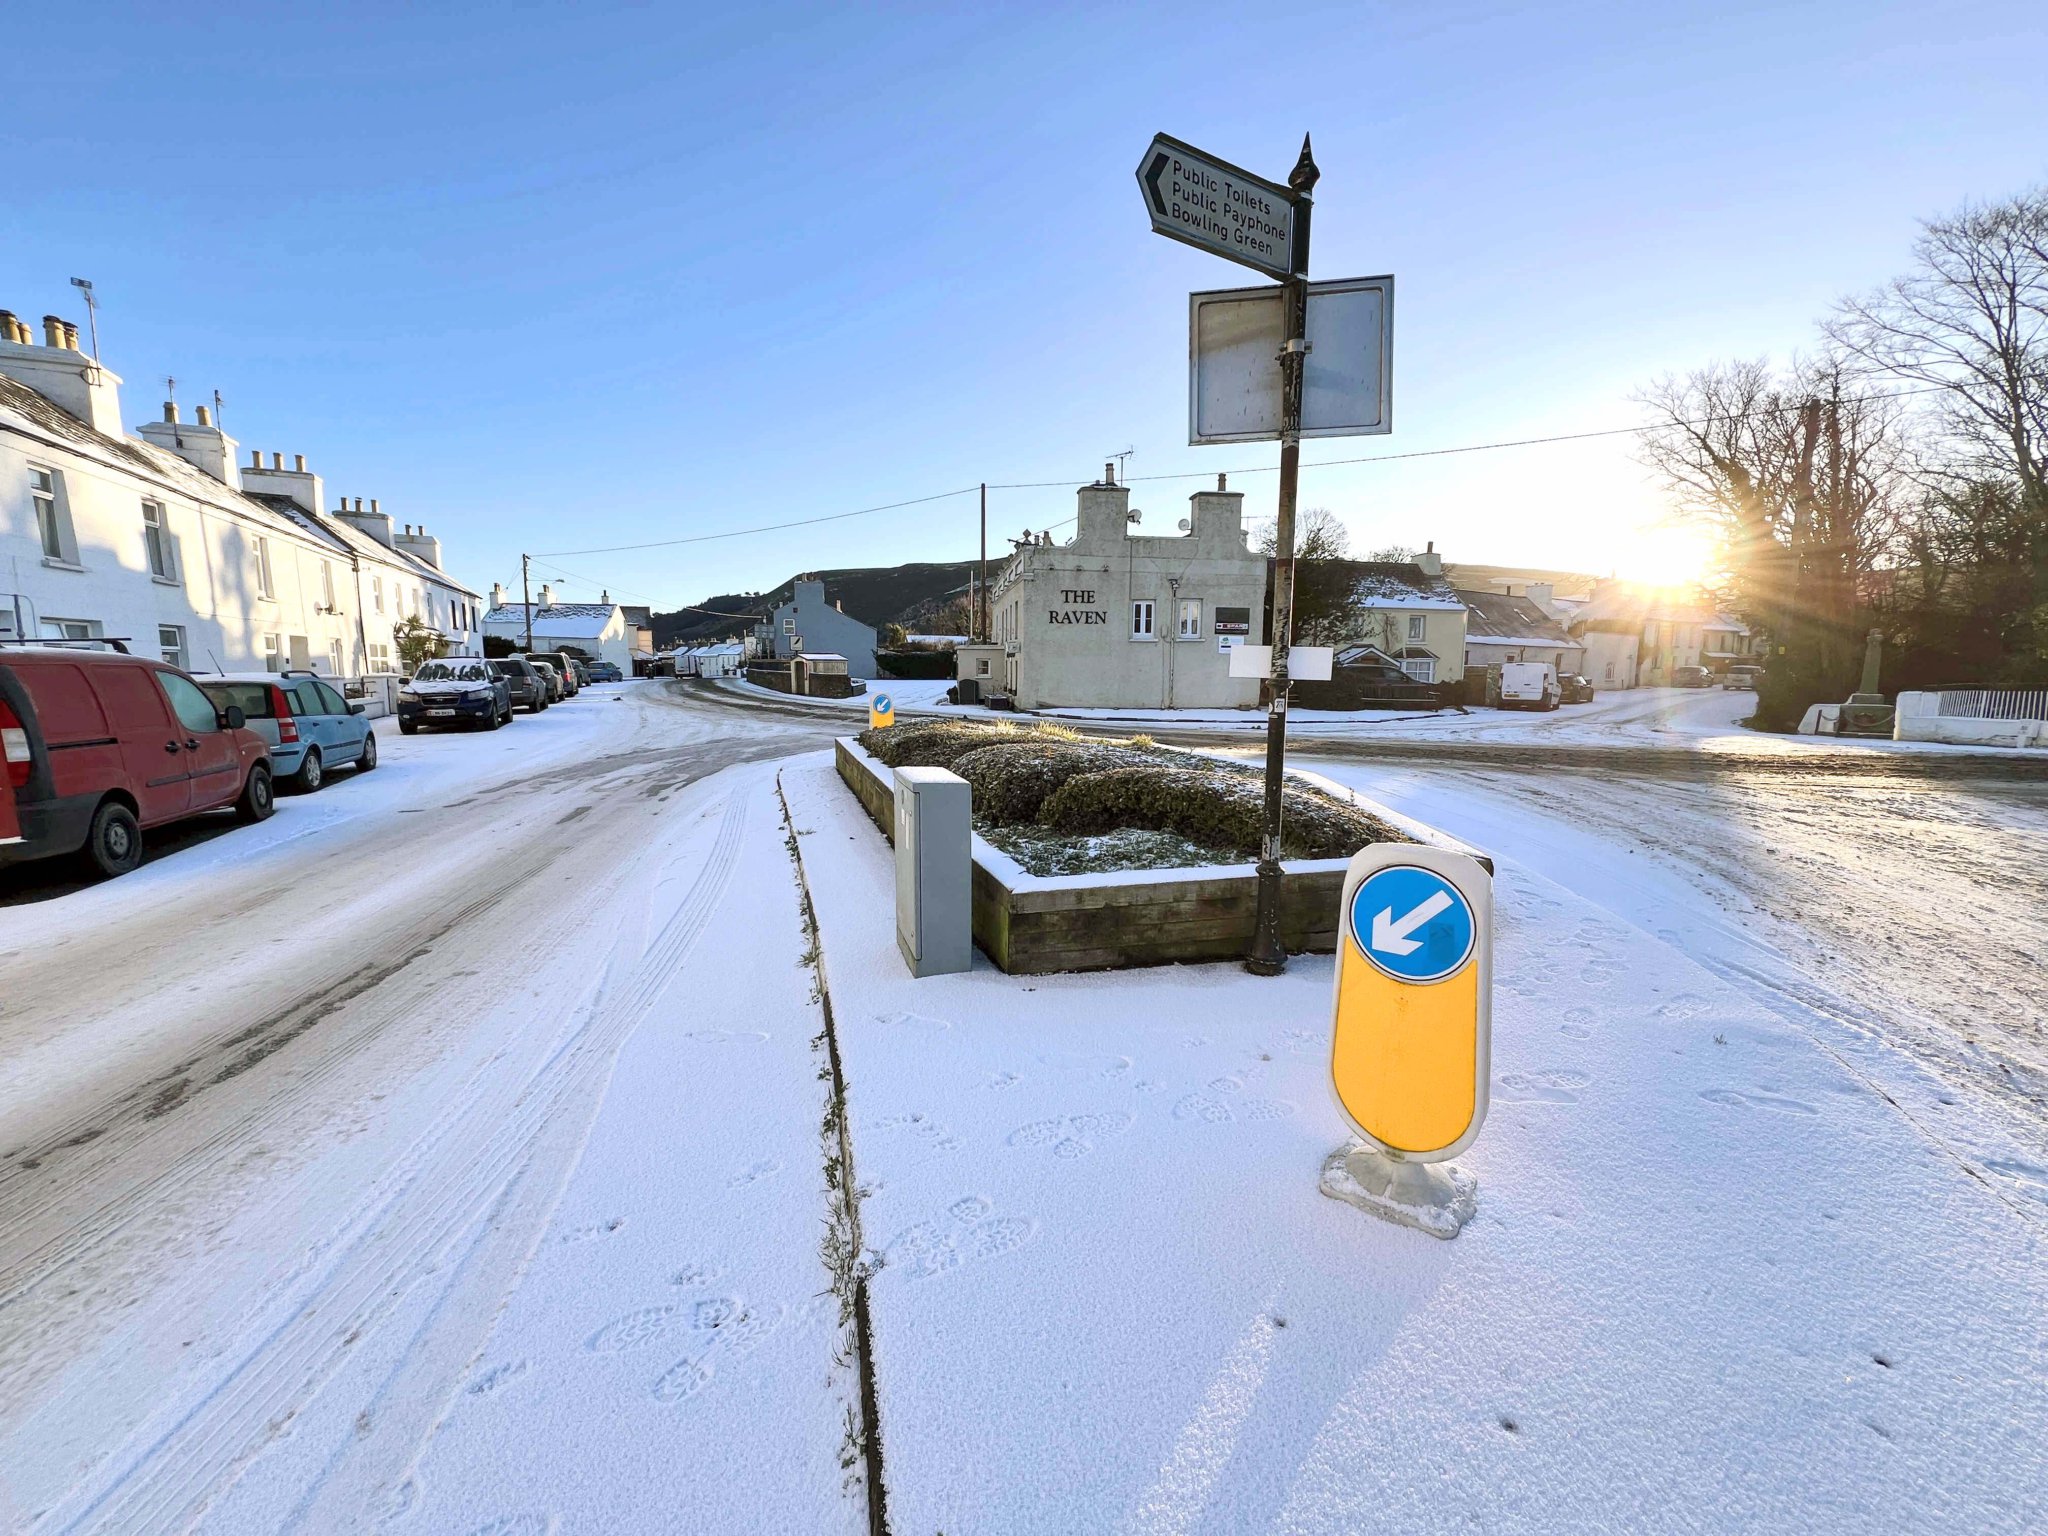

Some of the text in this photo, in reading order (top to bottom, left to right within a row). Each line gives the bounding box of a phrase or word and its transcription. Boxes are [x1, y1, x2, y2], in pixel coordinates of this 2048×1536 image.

[1173, 160, 1271, 215] Public Toilets
[1173, 181, 1285, 241] Public Payphone
[1172, 202, 1272, 256] Bowling Green
[1048, 610, 1108, 625] RAVEN
[1061, 590, 1095, 604] THE
